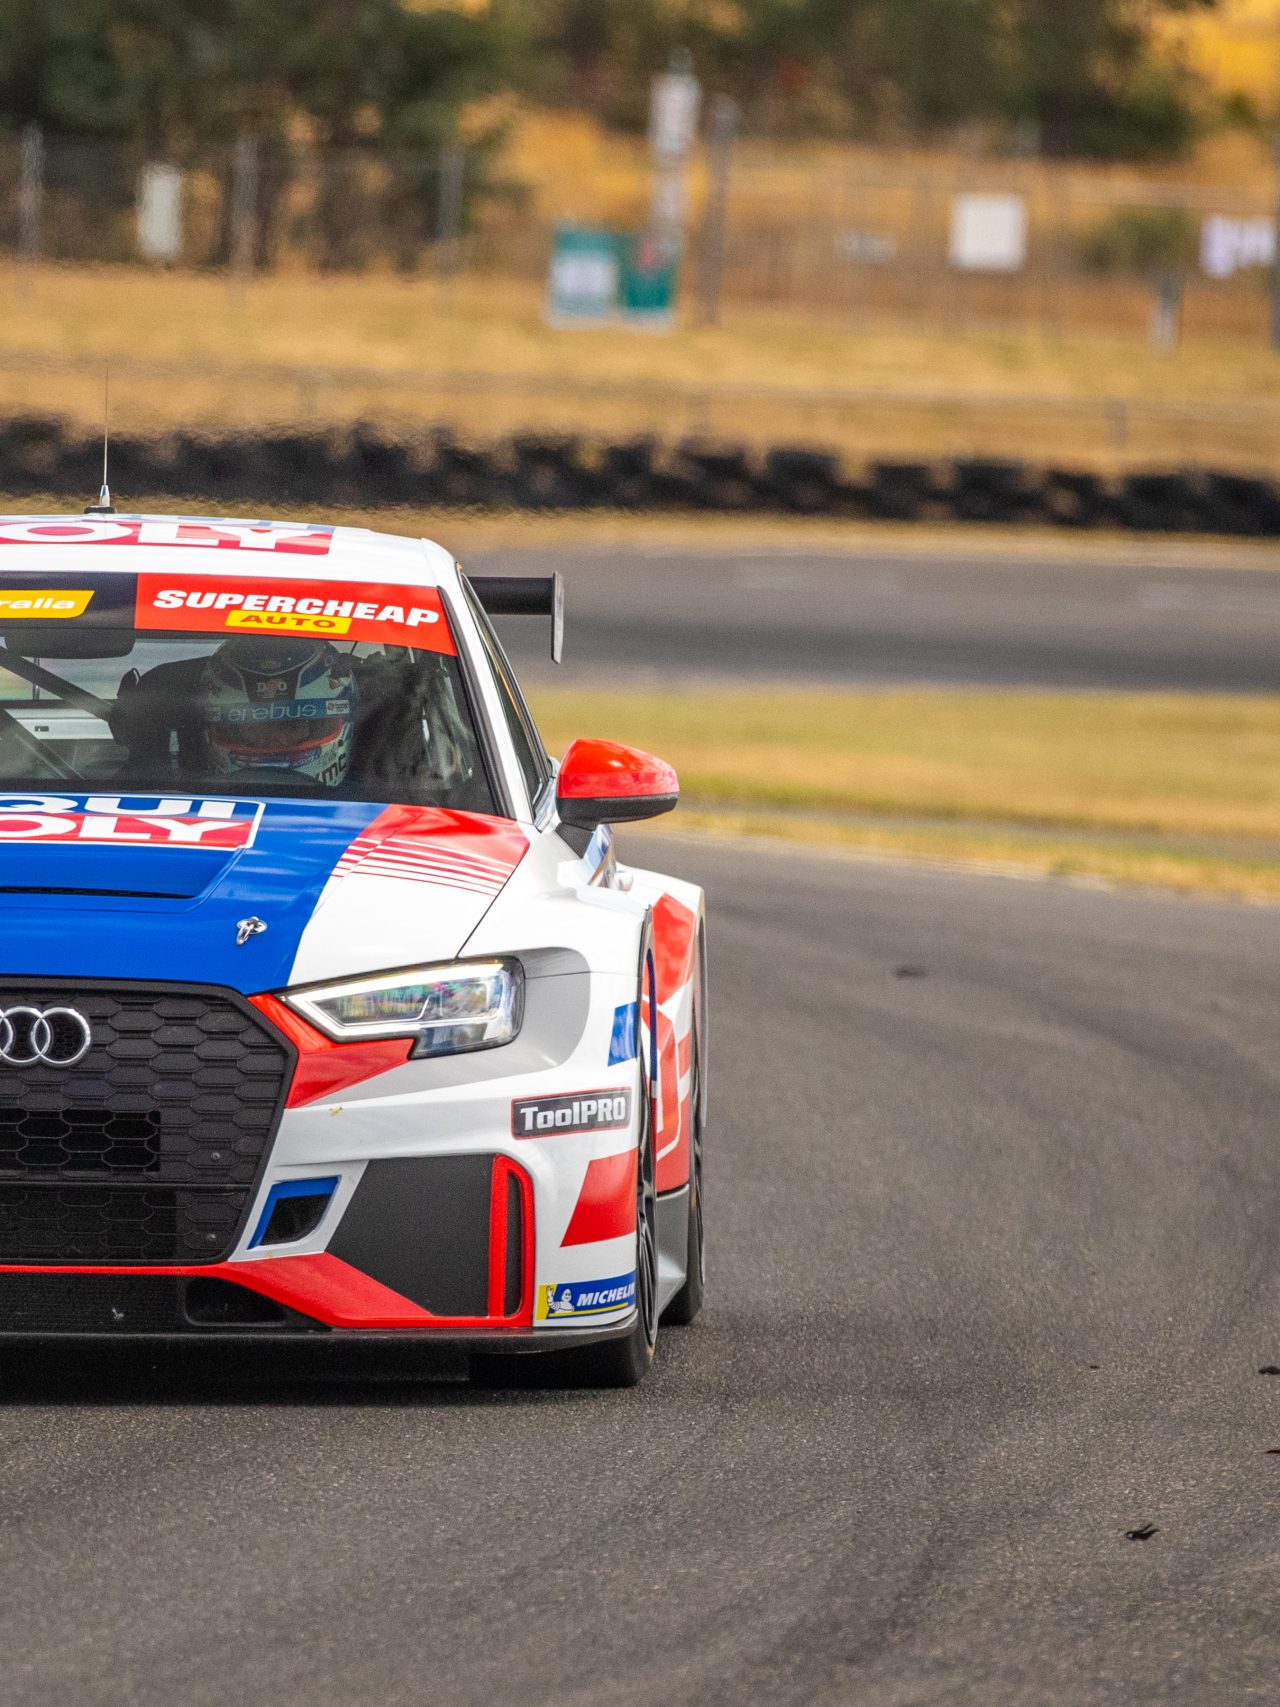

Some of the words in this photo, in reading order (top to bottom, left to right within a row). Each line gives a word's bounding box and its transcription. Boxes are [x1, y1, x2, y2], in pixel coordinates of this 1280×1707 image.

[153, 589, 440, 627] SUPERCHEAP
[240, 614, 336, 629] AUTO
[520, 1096, 626, 1132] ToolPRO
